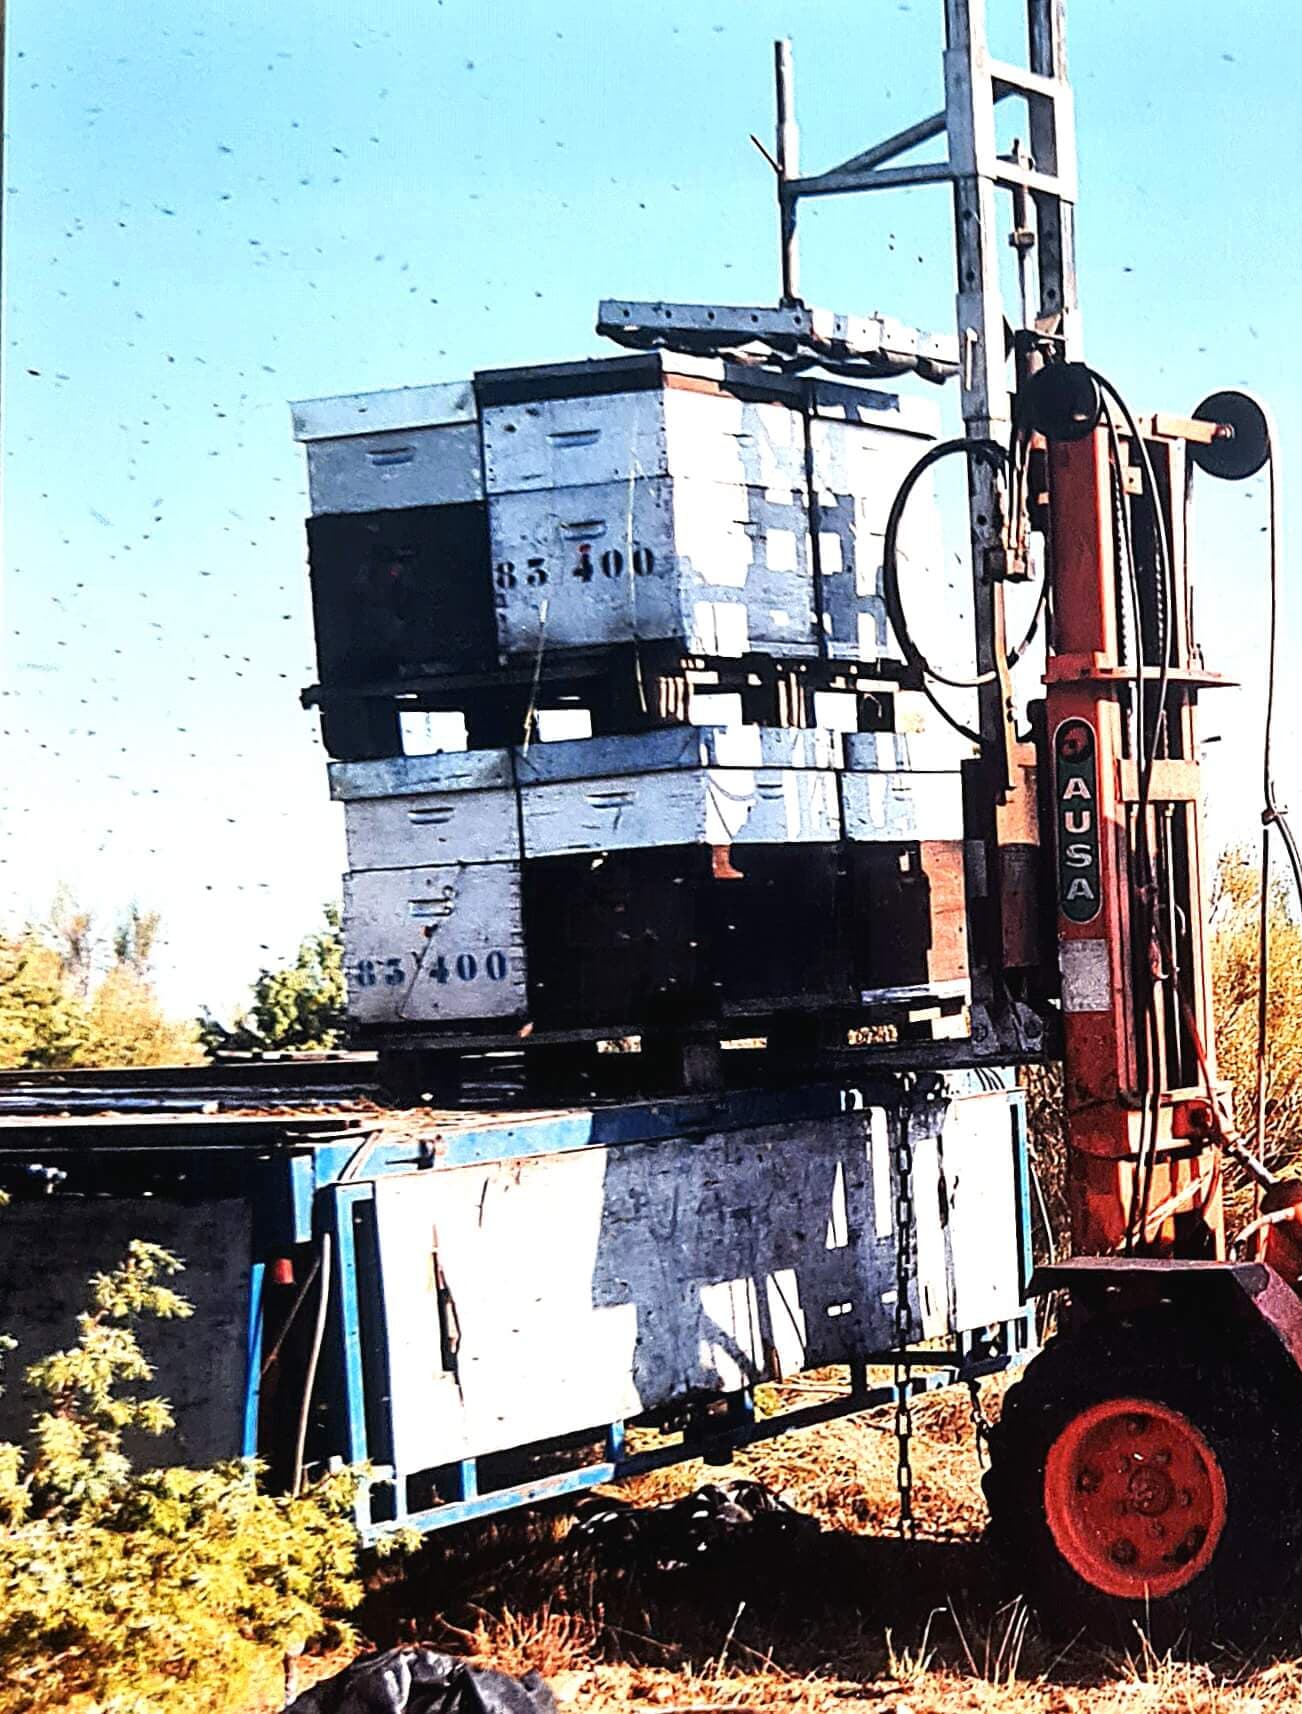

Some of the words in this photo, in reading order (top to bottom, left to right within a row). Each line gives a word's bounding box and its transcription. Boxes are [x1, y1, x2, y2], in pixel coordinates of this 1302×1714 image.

[573, 547, 654, 583] 400
[1062, 777, 1094, 900] AUSA
[429, 951, 507, 984] 400
